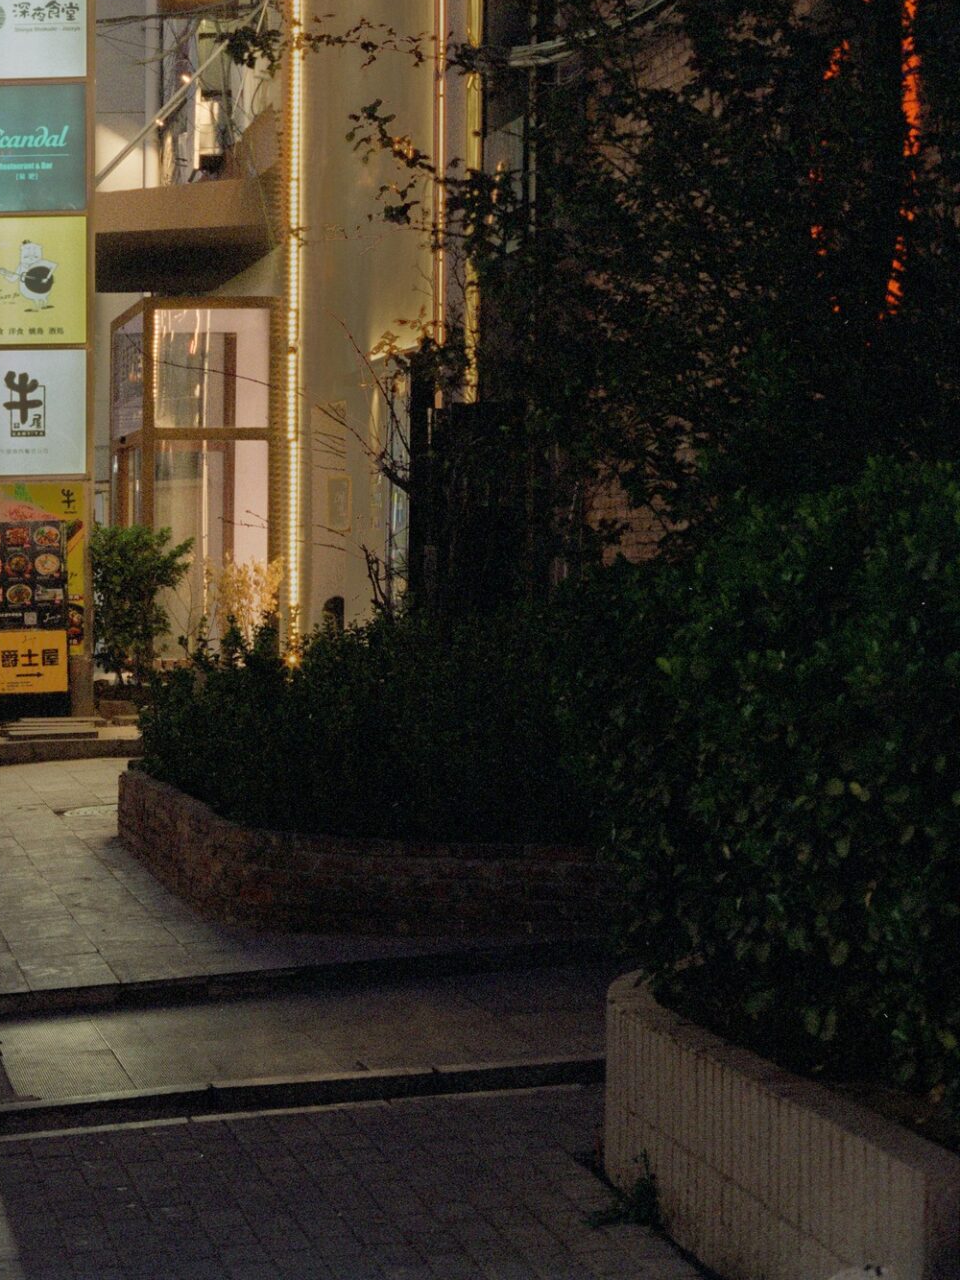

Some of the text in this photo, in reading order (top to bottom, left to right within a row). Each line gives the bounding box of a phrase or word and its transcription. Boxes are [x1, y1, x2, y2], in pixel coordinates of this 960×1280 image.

[12, 0, 80, 22] 深夜食堂
[1, 648, 59, 667] 爵士屋
